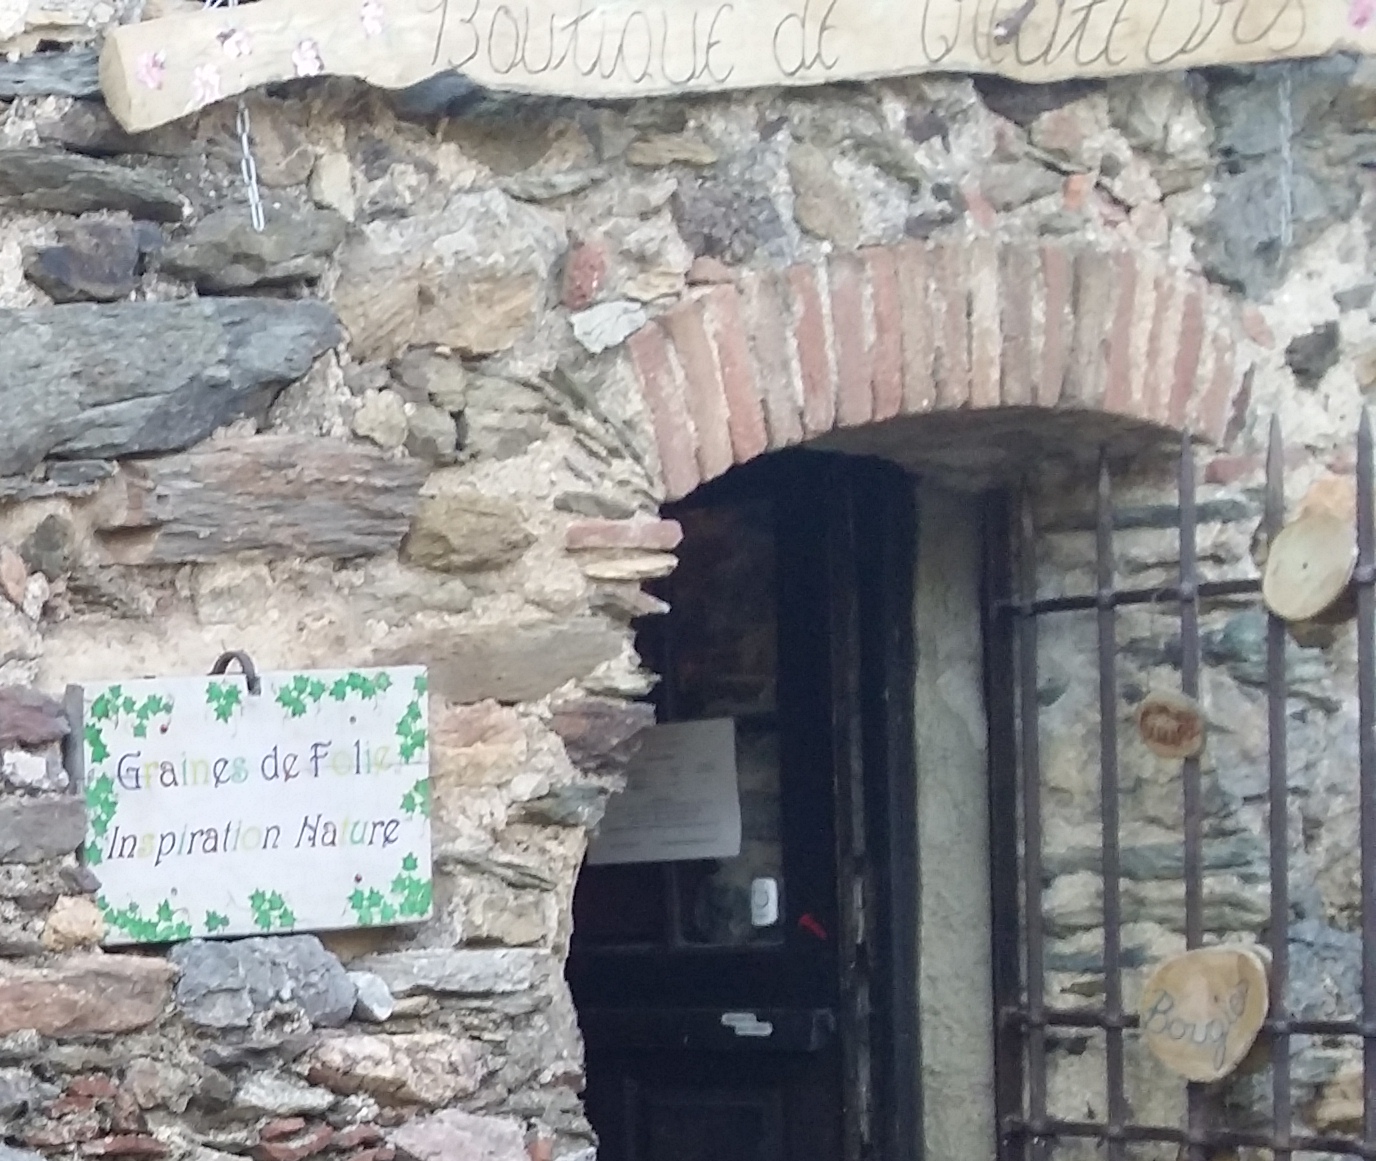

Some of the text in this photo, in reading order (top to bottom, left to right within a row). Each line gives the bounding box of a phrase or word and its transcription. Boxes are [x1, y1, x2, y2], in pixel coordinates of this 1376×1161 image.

[116, 739, 392, 791] Graines de Folie
[106, 813, 400, 868] Inspiration Nature
